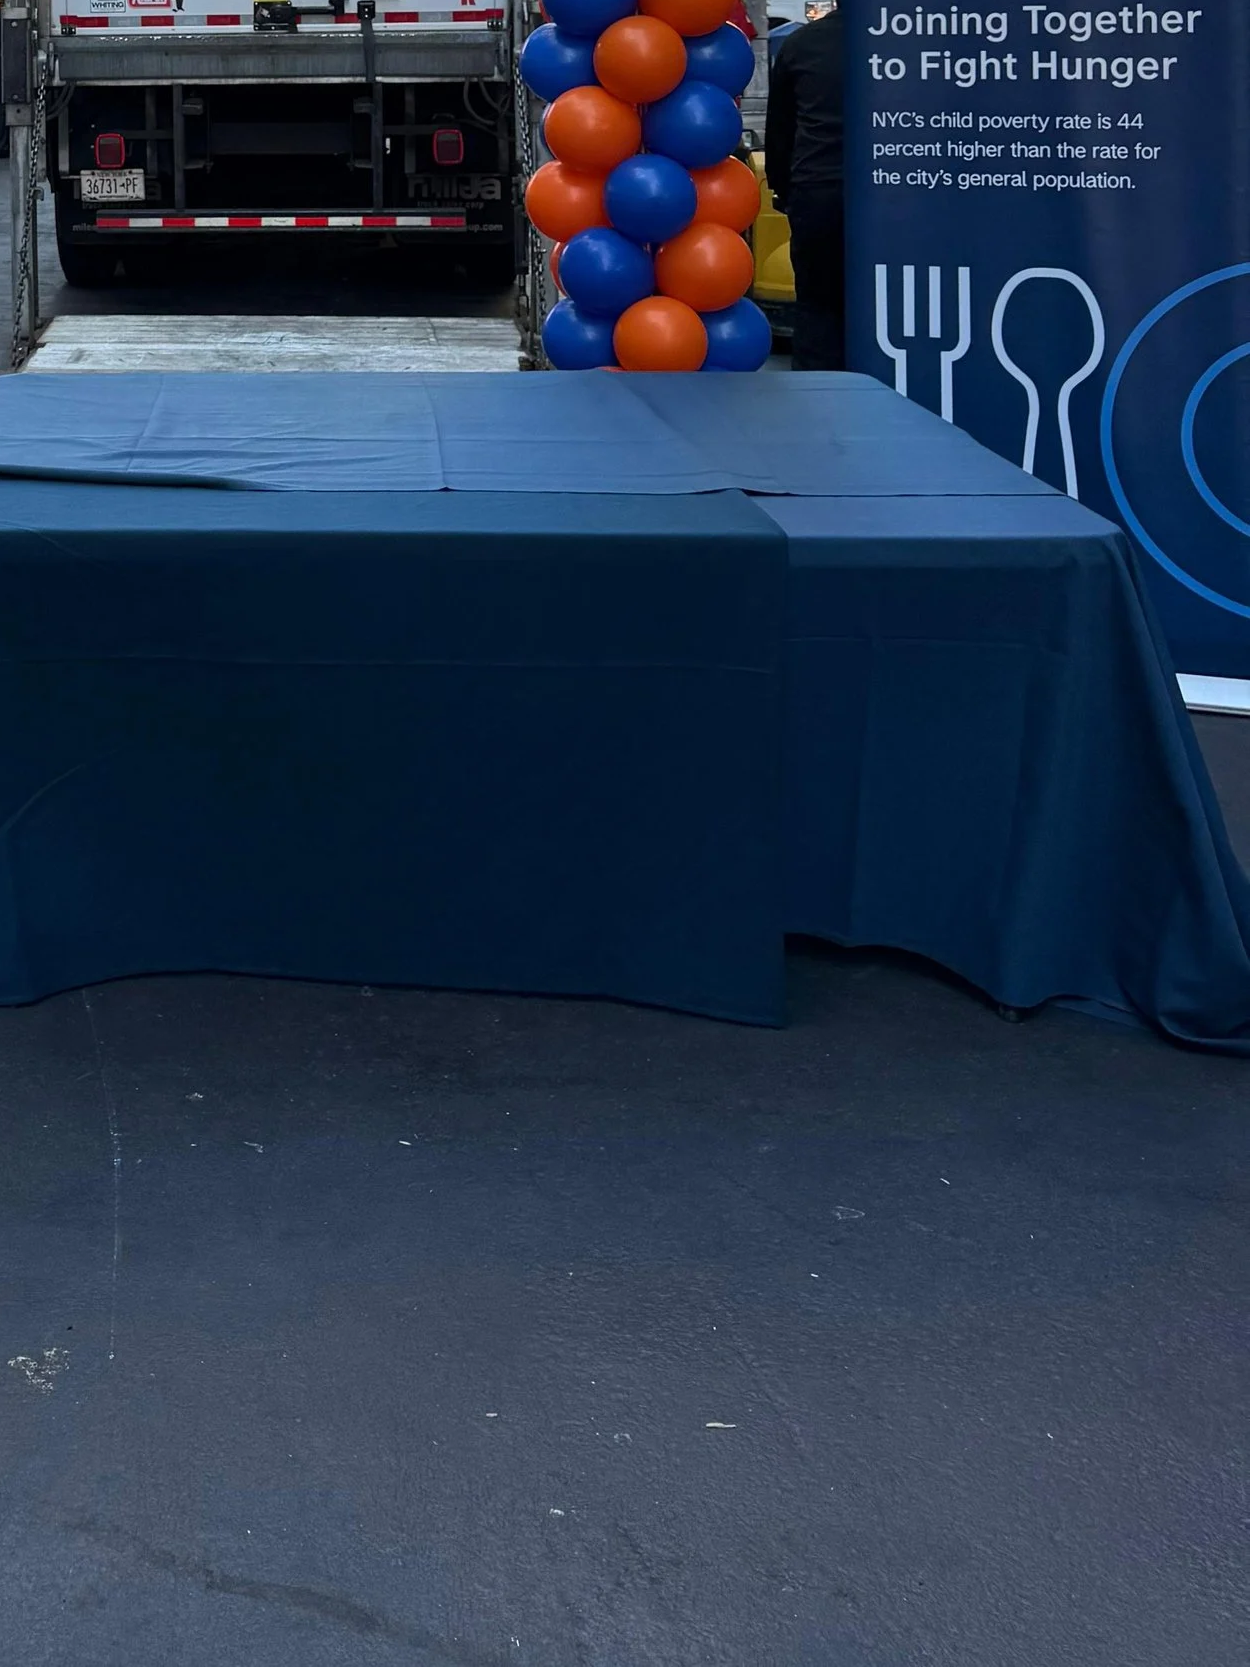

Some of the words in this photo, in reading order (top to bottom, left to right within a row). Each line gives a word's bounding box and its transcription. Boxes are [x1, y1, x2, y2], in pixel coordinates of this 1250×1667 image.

[91, 1, 125, 9] WHITING
[867, 5, 1008, 43] Joining
[1022, 3, 1202, 42] Together
[868, 53, 906, 80] to
[920, 50, 1018, 88] Fight
[1032, 50, 1178, 88] Hunger
[929, 111, 973, 128] child
[978, 113, 1049, 133] poverty
[1055, 113, 1092, 129] rate
[1097, 112, 1112, 130] is
[1117, 113, 1144, 130] 44
[873, 142, 942, 163] percent
[947, 140, 1004, 162] higher
[1010, 141, 1051, 159] than
[1056, 141, 1087, 159] the
[1092, 143, 1129, 160] rate
[1134, 142, 1162, 160] for
[872, 168, 901, 186] the
[957, 170, 1028, 192] general
[1033, 171, 1136, 193] population.
